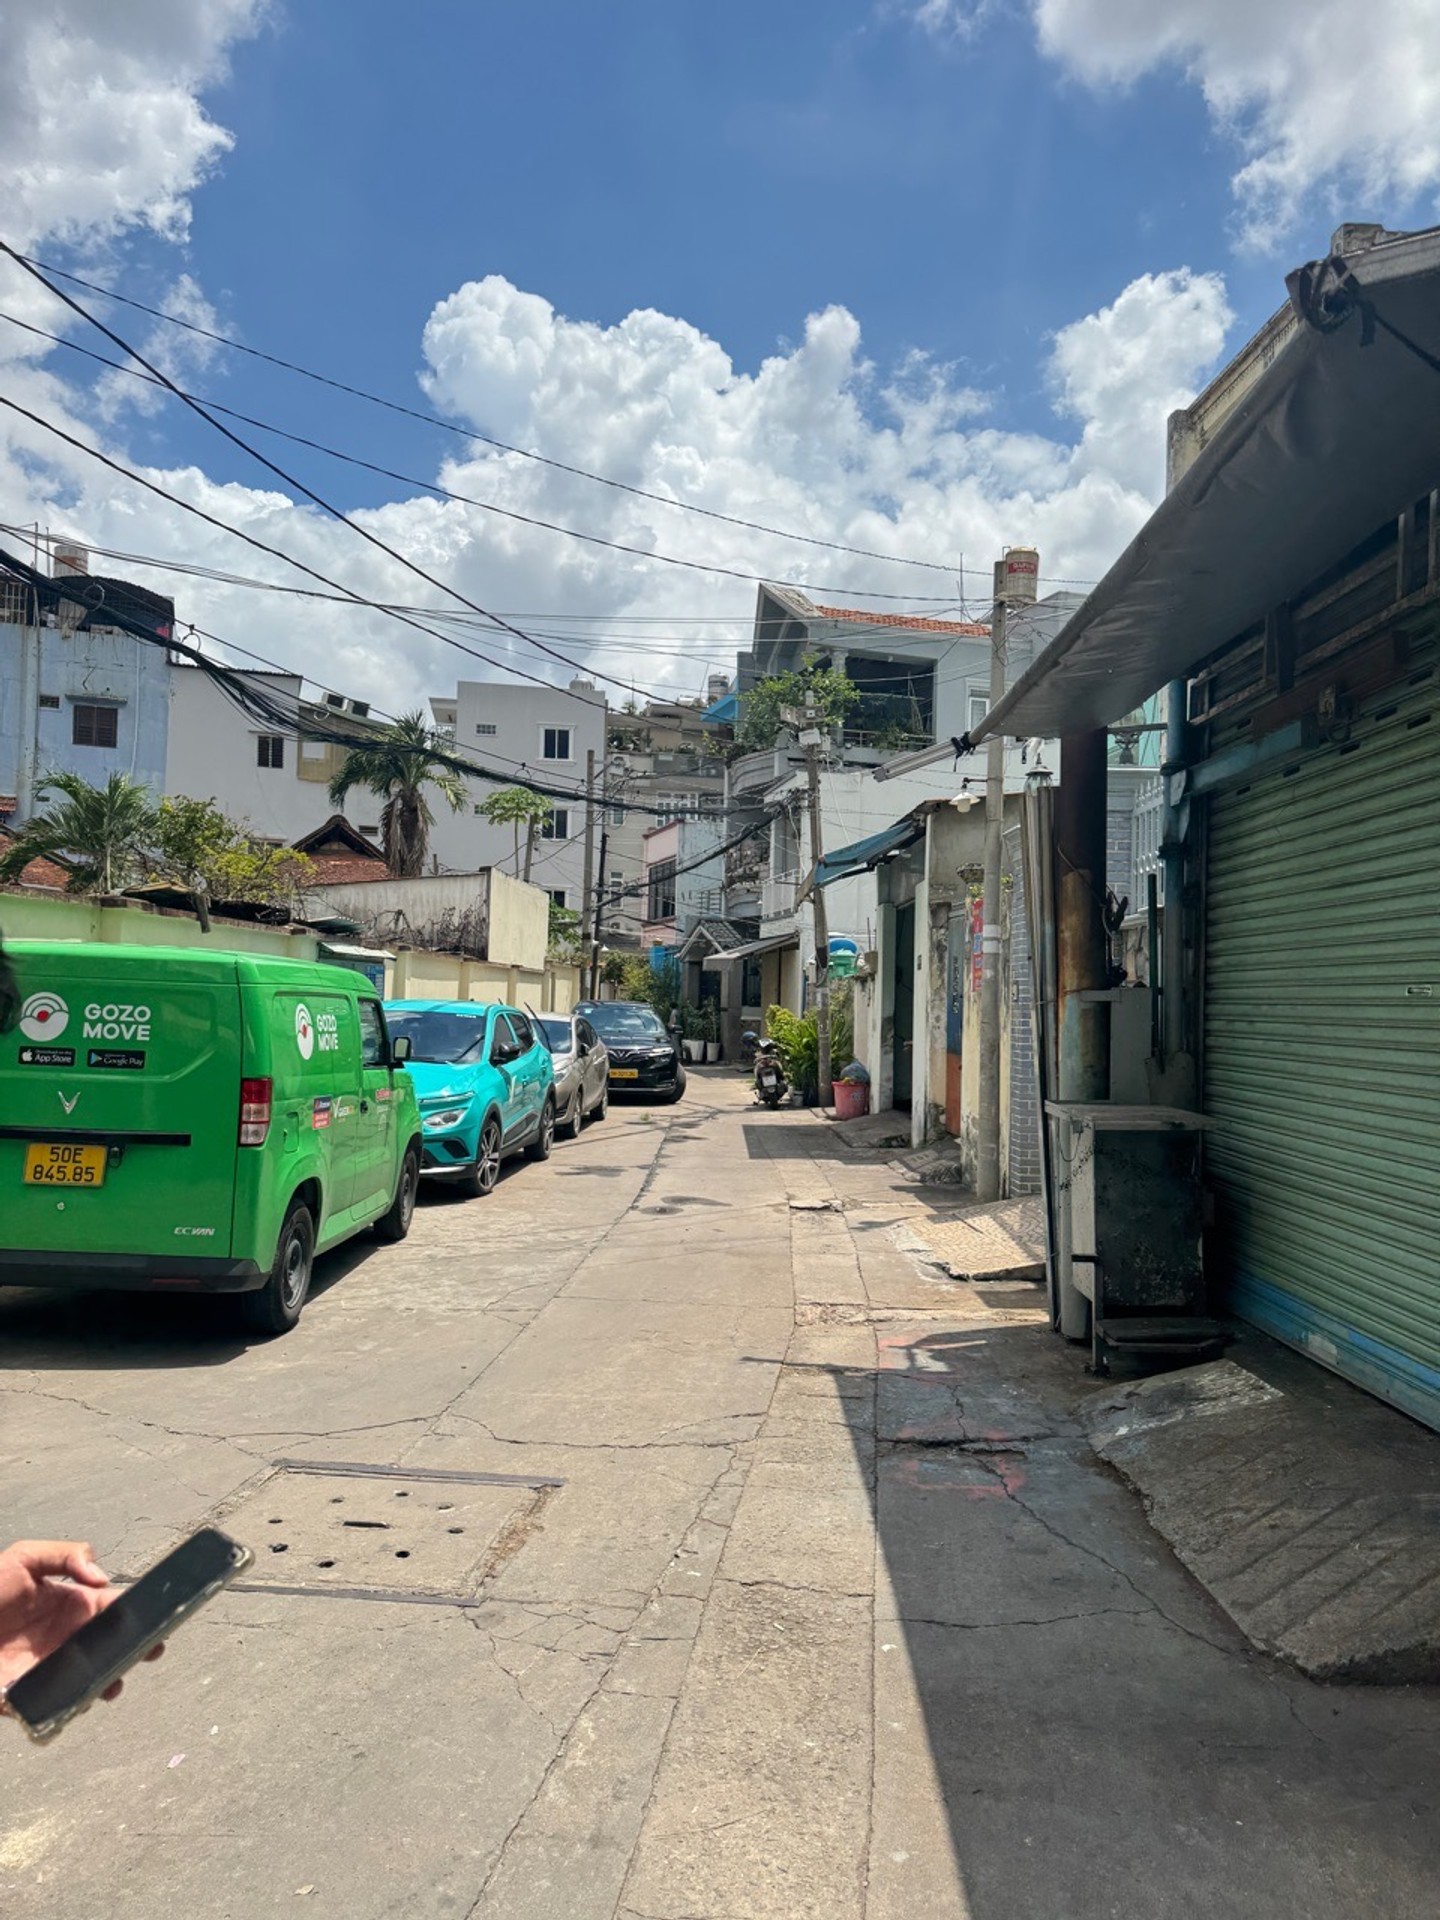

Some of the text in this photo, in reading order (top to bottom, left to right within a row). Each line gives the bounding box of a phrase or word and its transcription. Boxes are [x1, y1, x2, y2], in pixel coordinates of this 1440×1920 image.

[84, 1003, 151, 1022] GOZO
[82, 1022, 151, 1041] MOVE
[316, 1013, 337, 1032] GOZO
[318, 1033, 339, 1051] MOVE
[34, 1053, 72, 1064] App Store
[49, 1146, 84, 1164] 50E
[32, 1164, 96, 1183] 845.85
